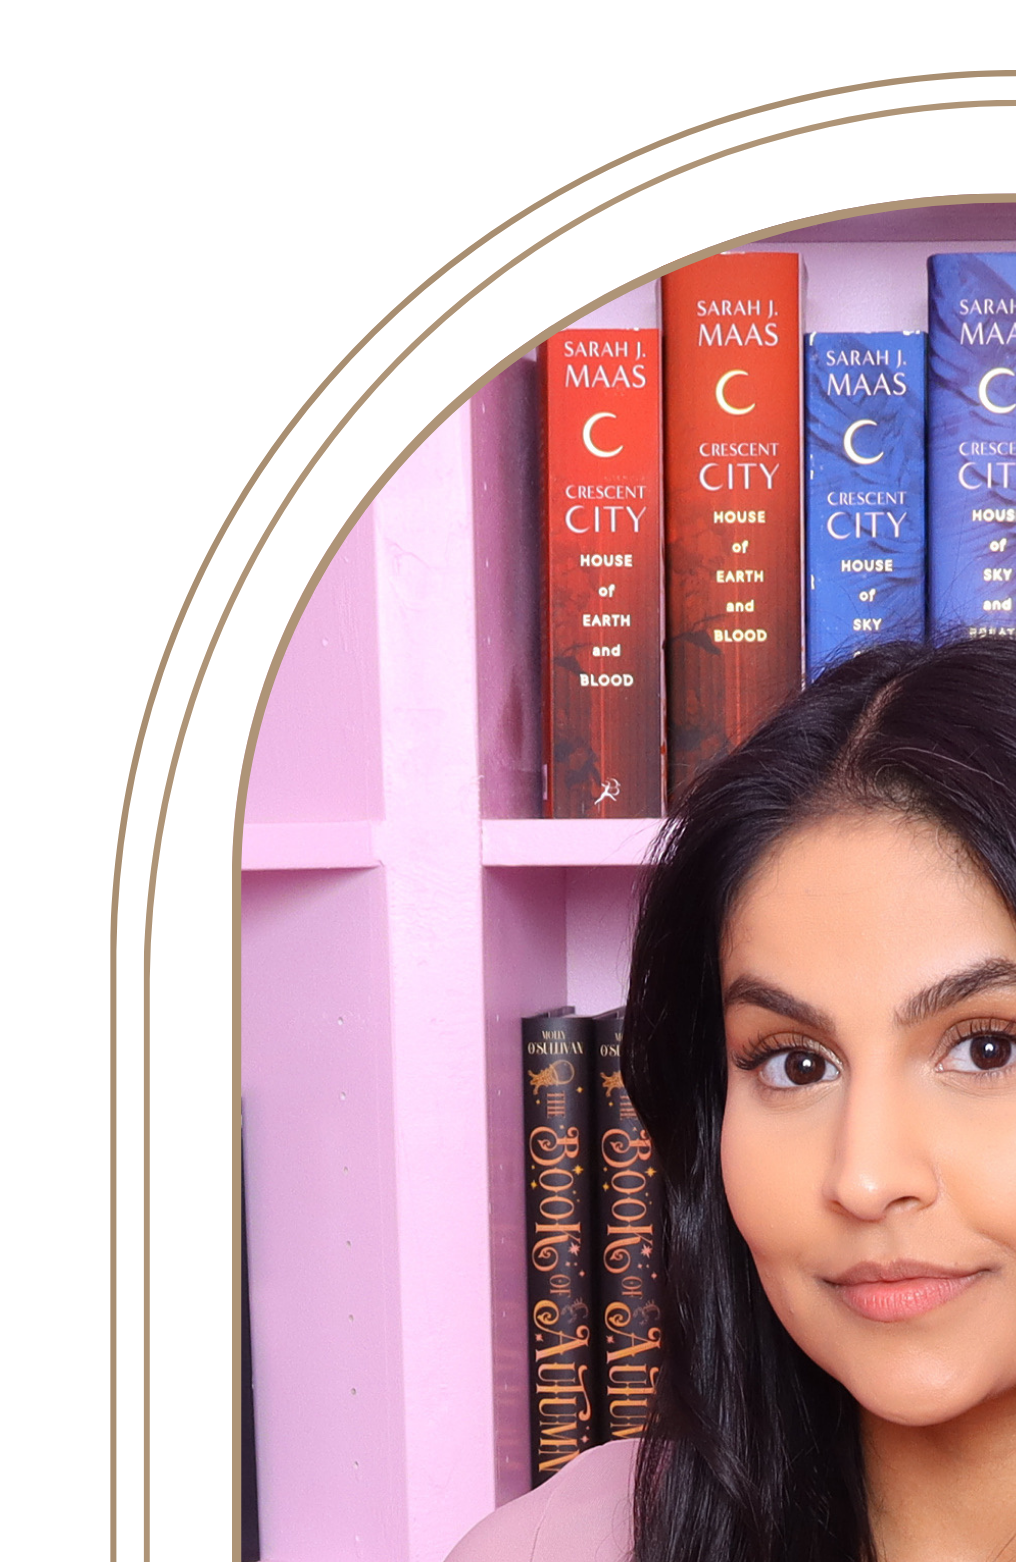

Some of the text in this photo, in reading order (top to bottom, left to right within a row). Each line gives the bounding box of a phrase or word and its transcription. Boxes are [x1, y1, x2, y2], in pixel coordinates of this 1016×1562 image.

[698, 300, 778, 318] SARAH J.
[699, 323, 778, 346] MAAS
[565, 341, 645, 359] SARAH J.
[827, 350, 906, 368] SARAH J.
[566, 365, 645, 388] MAAS
[828, 372, 906, 395] MAAS
[700, 443, 776, 456] CRESCENT
[700, 463, 779, 490] CITY
[566, 486, 645, 499] CRESCENT
[827, 492, 903, 505] CRESCENT
[566, 506, 646, 533] CITY
[714, 511, 765, 523] HOUSE
[827, 512, 906, 539] CITY
[732, 541, 748, 553] of
[990, 538, 1007, 552] of
[581, 554, 632, 567] HOUSE
[842, 559, 892, 572] HOUSE
[717, 570, 763, 583] EARTH
[984, 568, 1012, 581] SKY
[599, 584, 615, 597] of
[859, 589, 876, 602] of
[727, 600, 754, 612] and
[983, 598, 1012, 611] and
[583, 615, 630, 626] EARTH
[853, 618, 881, 631] SKY
[714, 630, 767, 642] BLOOD
[593, 644, 620, 656] and
[580, 674, 633, 686] BLOOD
[542, 1031, 566, 1040] MOLLY
[527, 1042, 584, 1055] O'SULLIVAN
[601, 1129, 653, 1274] BOOK
[529, 1091, 591, 1472] THE BOOK OF AUTUMN
[621, 1276, 643, 1299] OF
[604, 1301, 662, 1440] AUTUM
